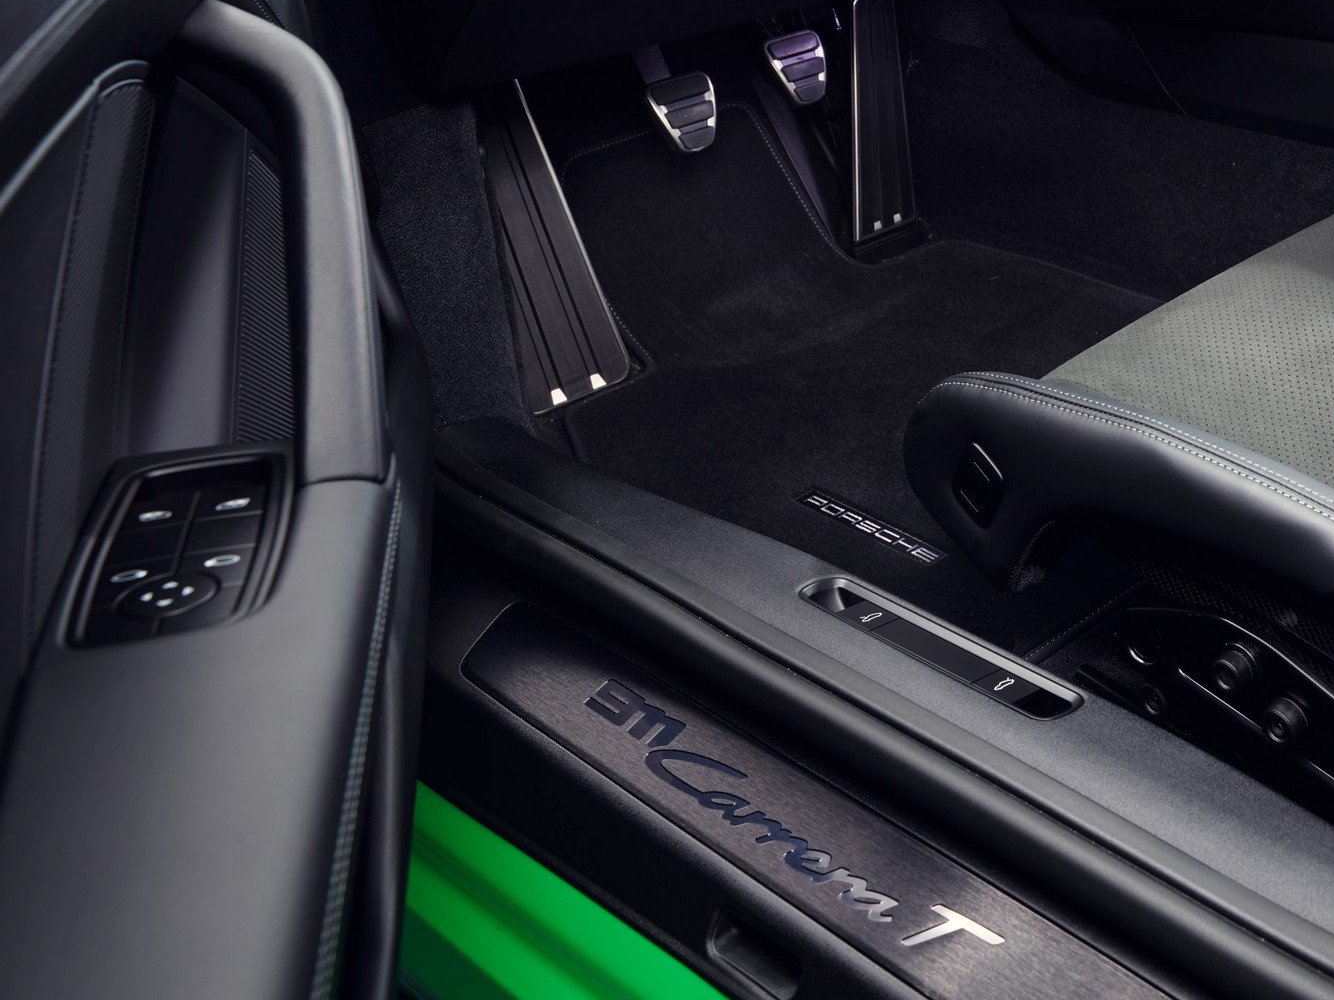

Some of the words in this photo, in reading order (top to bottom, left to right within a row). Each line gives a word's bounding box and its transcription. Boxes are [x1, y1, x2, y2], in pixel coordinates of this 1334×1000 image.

[804, 495, 939, 563] PORSCHE
[643, 748, 899, 923] Carrera
[901, 903, 1006, 946] T
